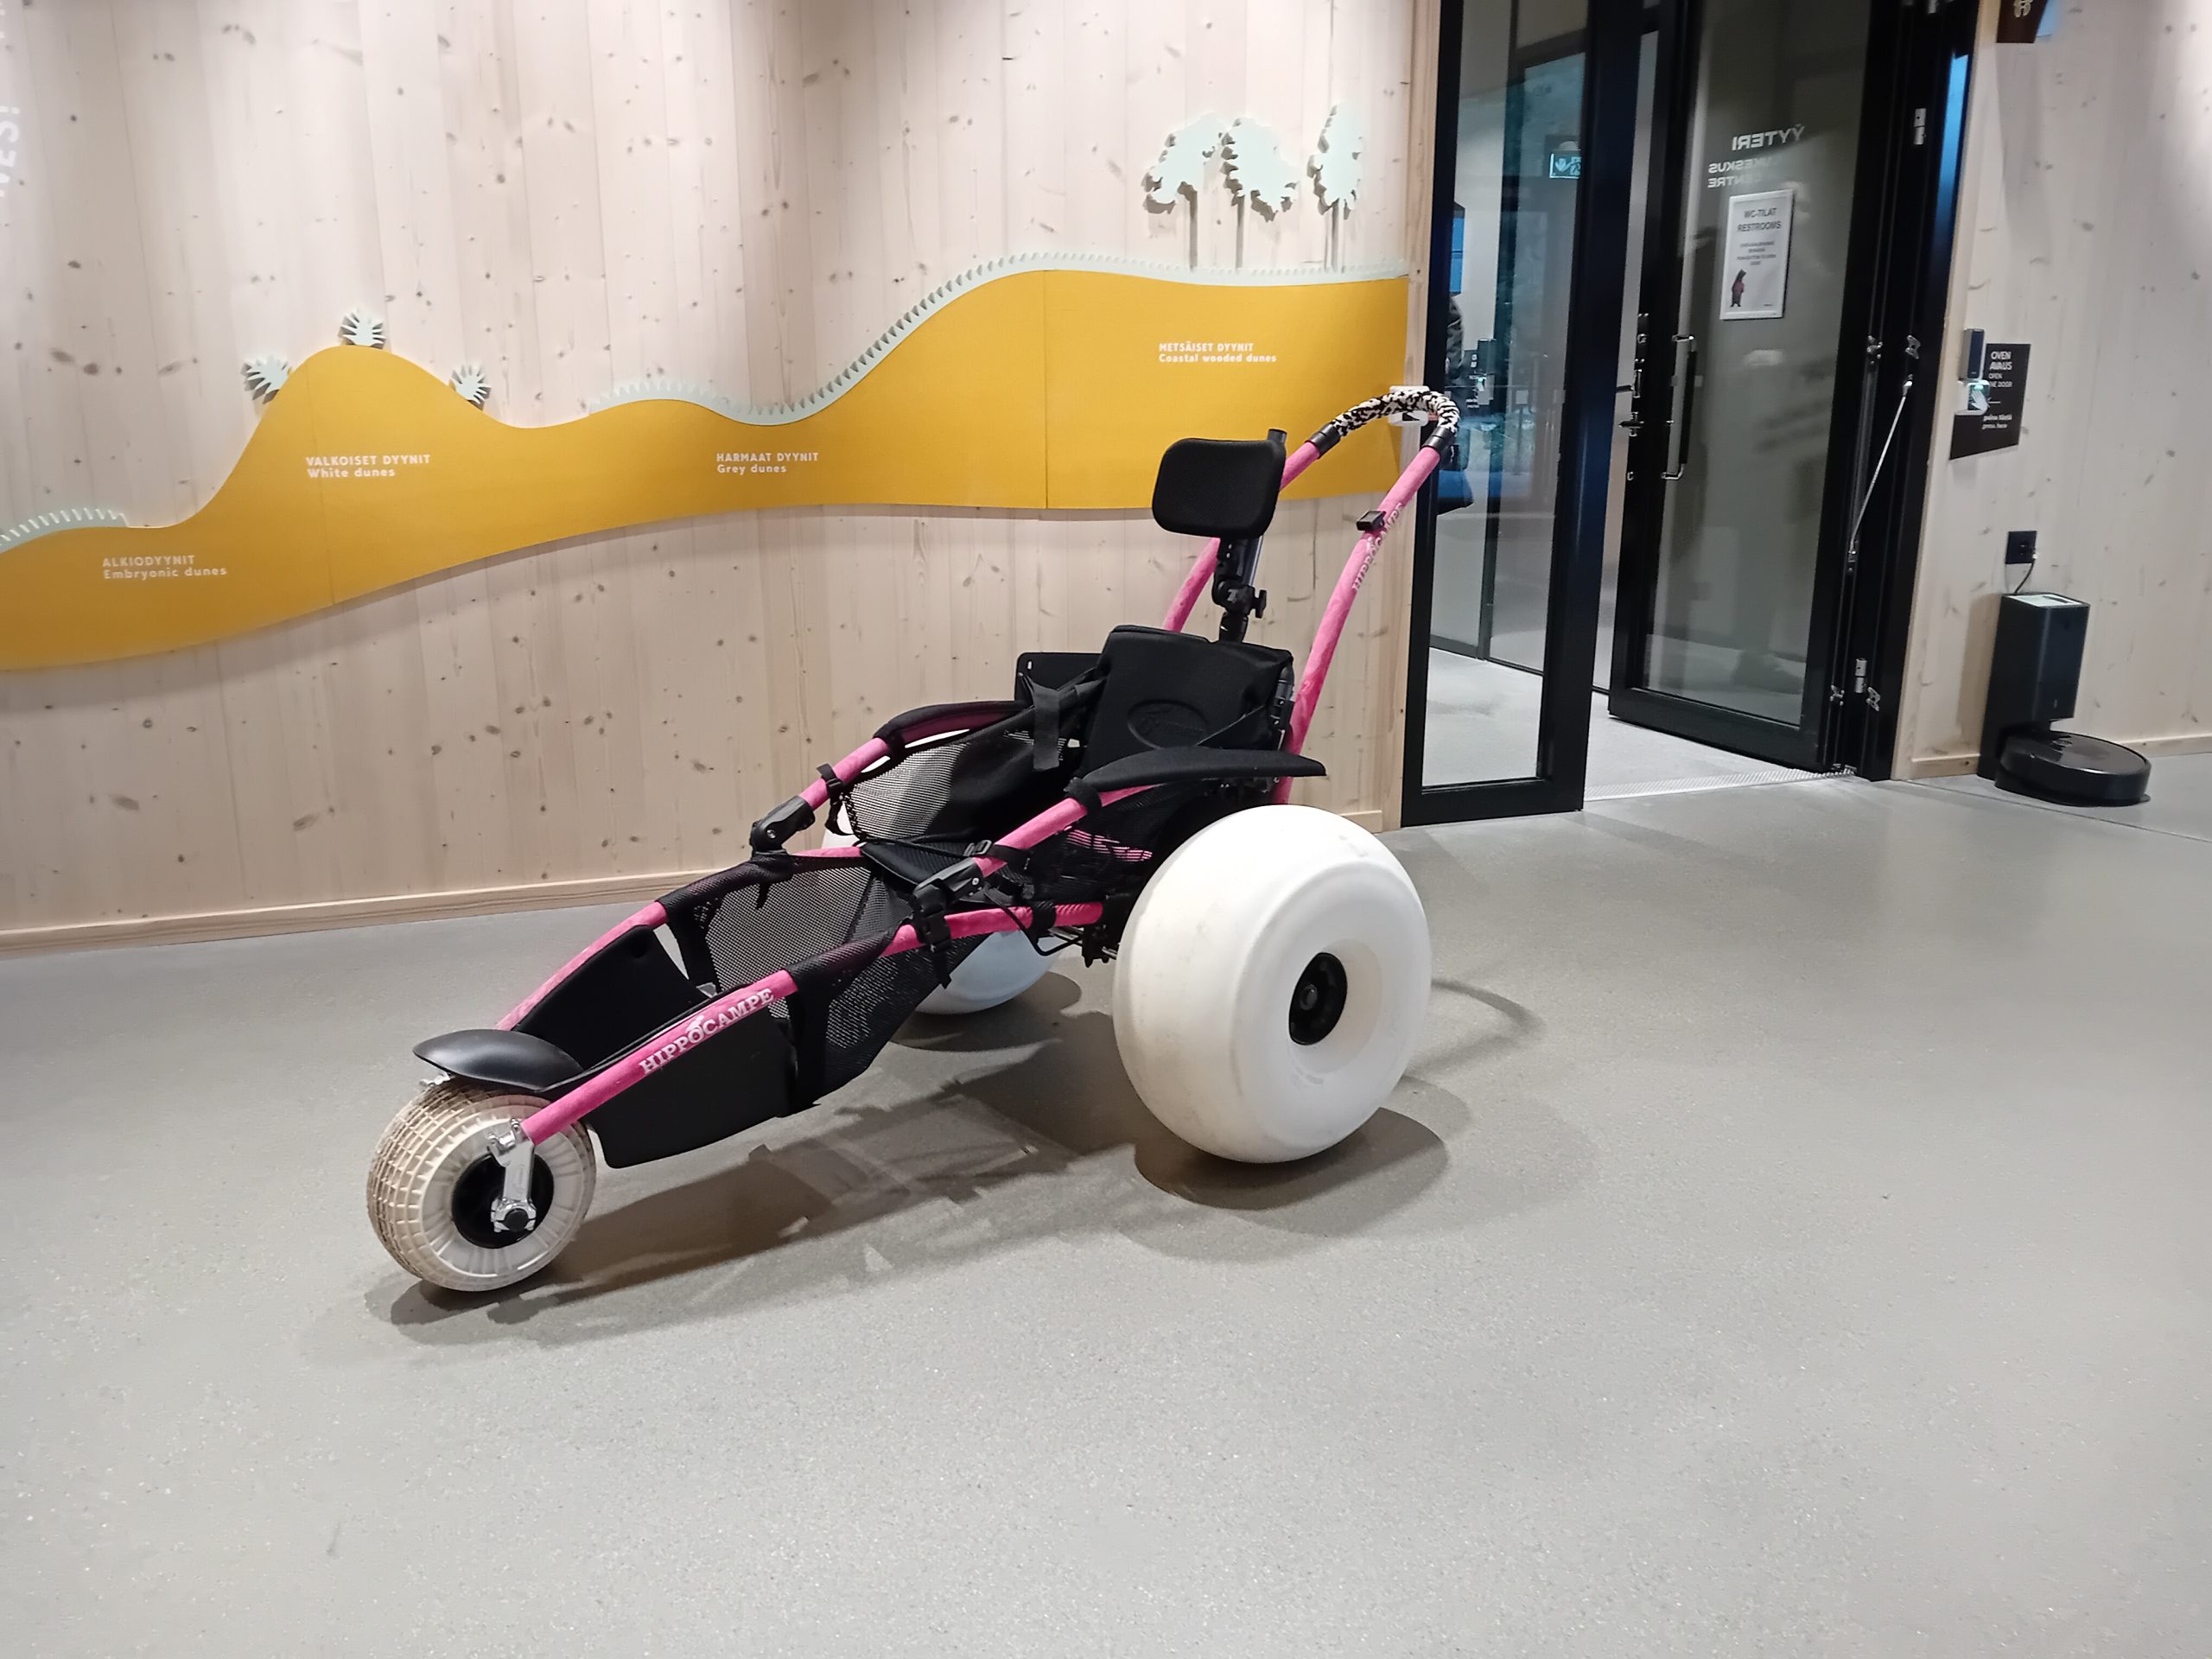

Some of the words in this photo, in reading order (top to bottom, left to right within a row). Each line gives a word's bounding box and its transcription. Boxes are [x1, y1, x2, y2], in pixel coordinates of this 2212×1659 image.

[1744, 207, 1777, 219] WC-TILAT
[1737, 220, 1782, 232] RESTROOMS
[1159, 340, 1214, 352] METSÄISET
[1217, 343, 1254, 352] DYYNIT
[1159, 353, 1199, 362] Coastal
[1202, 353, 1243, 362] wooded
[1245, 353, 1277, 362] dunes
[1991, 351, 2012, 360] OVEN
[306, 455, 377, 467] VALKOISET
[383, 454, 430, 465] DYYNIT
[716, 453, 772, 462] HARMAAT
[777, 452, 818, 462] DYYNIT
[307, 467, 349, 478] White
[354, 467, 396, 477] dunes
[716, 464, 746, 475] Grey
[750, 464, 787, 474] dunes
[102, 555, 195, 568] ALKIODYYNIT
[103, 567, 179, 581] Embryonic
[184, 567, 227, 576] dunes
[639, 988, 774, 1074] HIPPOCAMPE
